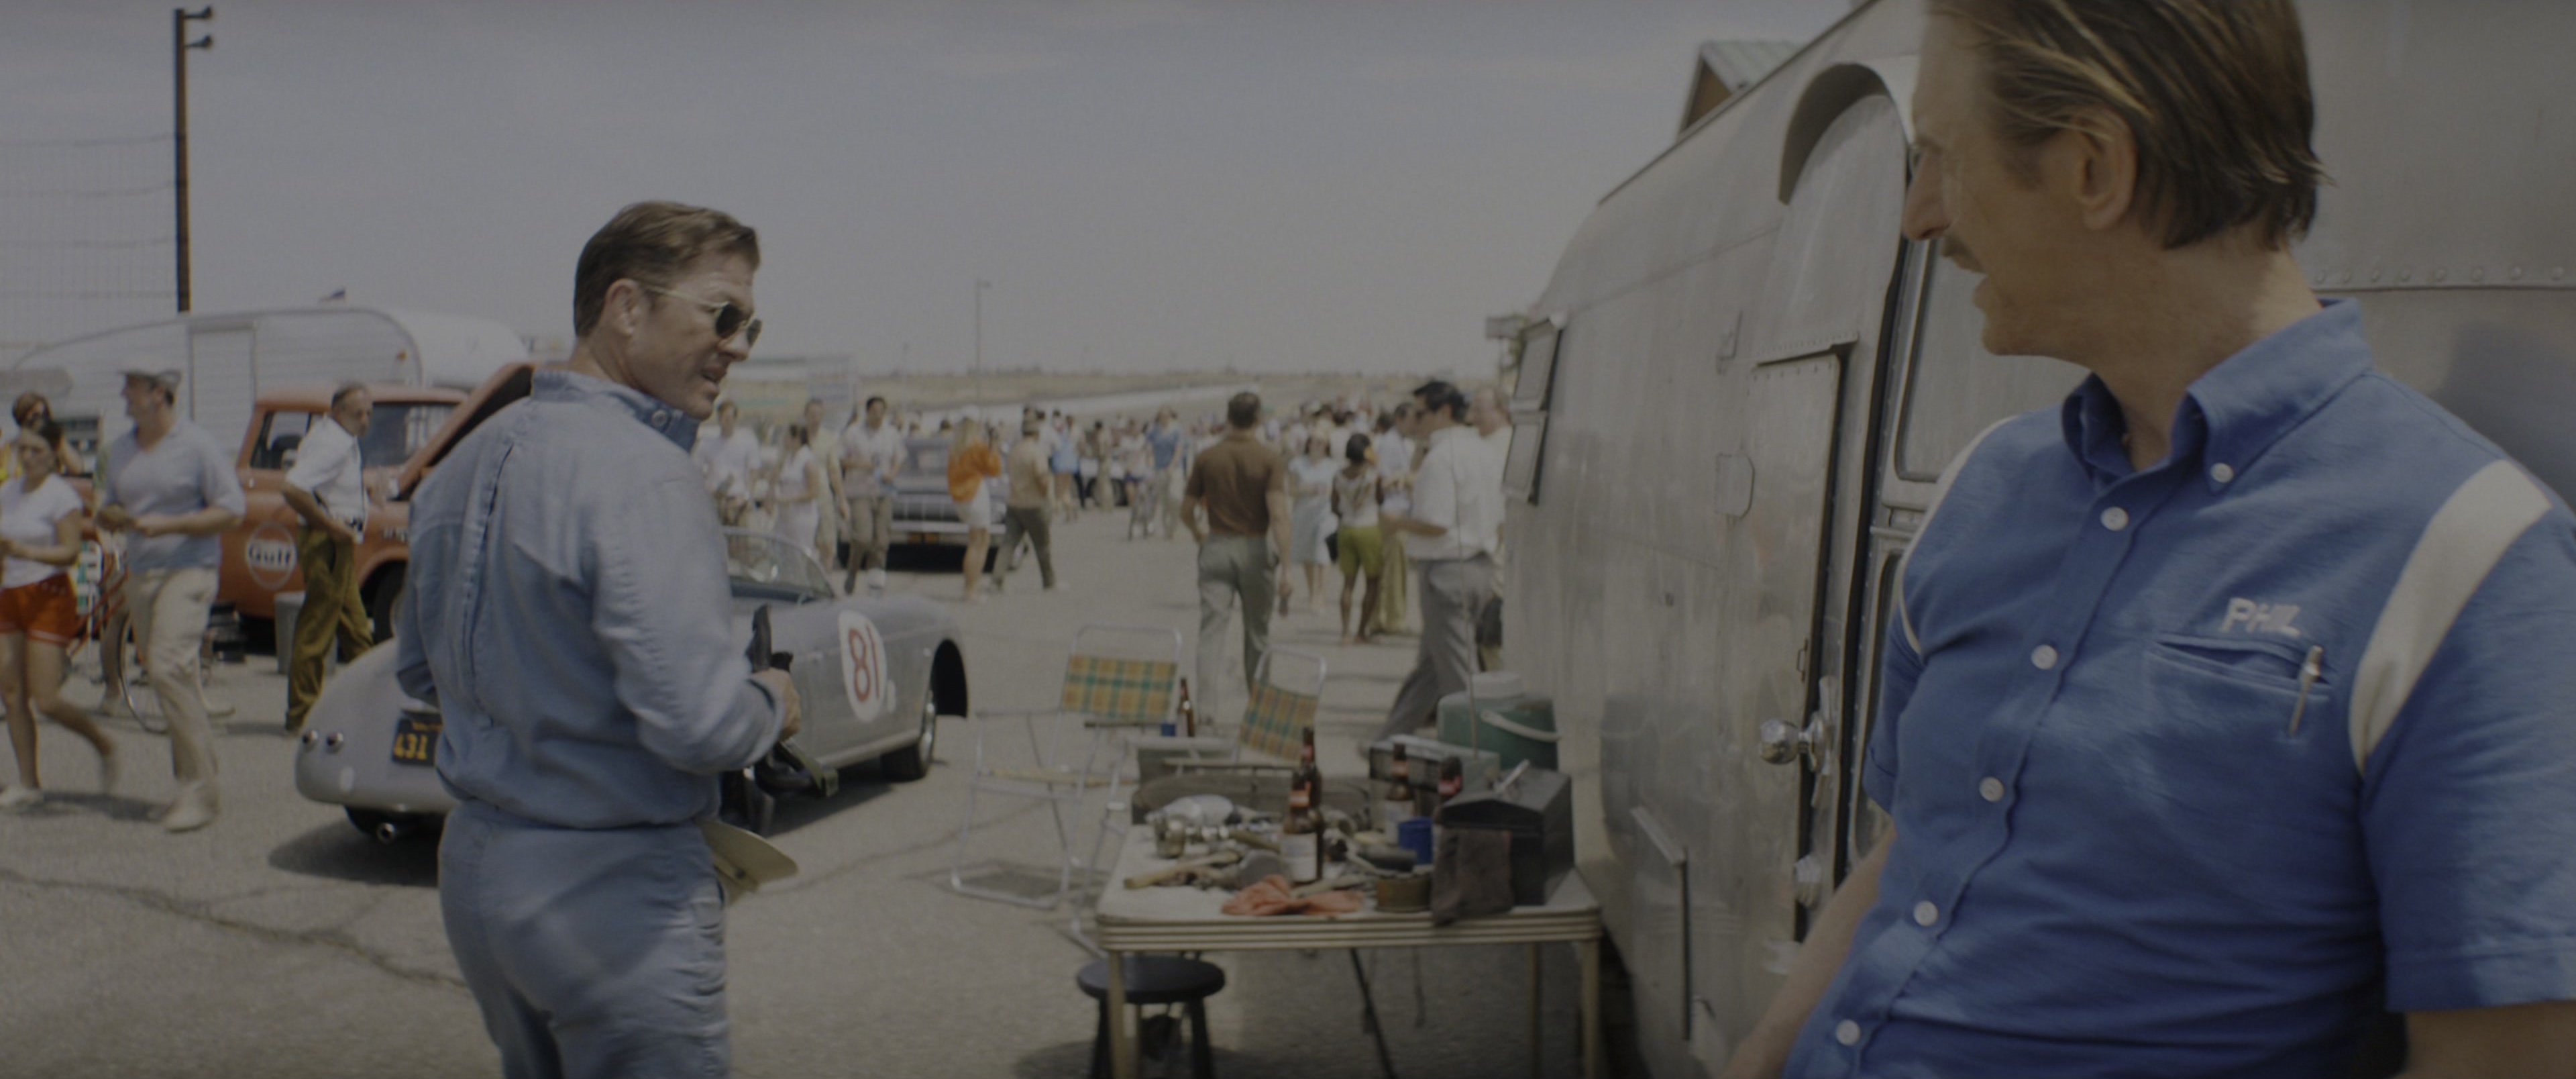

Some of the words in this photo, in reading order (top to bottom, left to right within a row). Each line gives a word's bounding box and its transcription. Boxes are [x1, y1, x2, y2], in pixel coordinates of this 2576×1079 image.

[248, 543, 290, 564] Gulf
[2220, 597, 2301, 637] PHIL
[847, 622, 880, 703] 81
